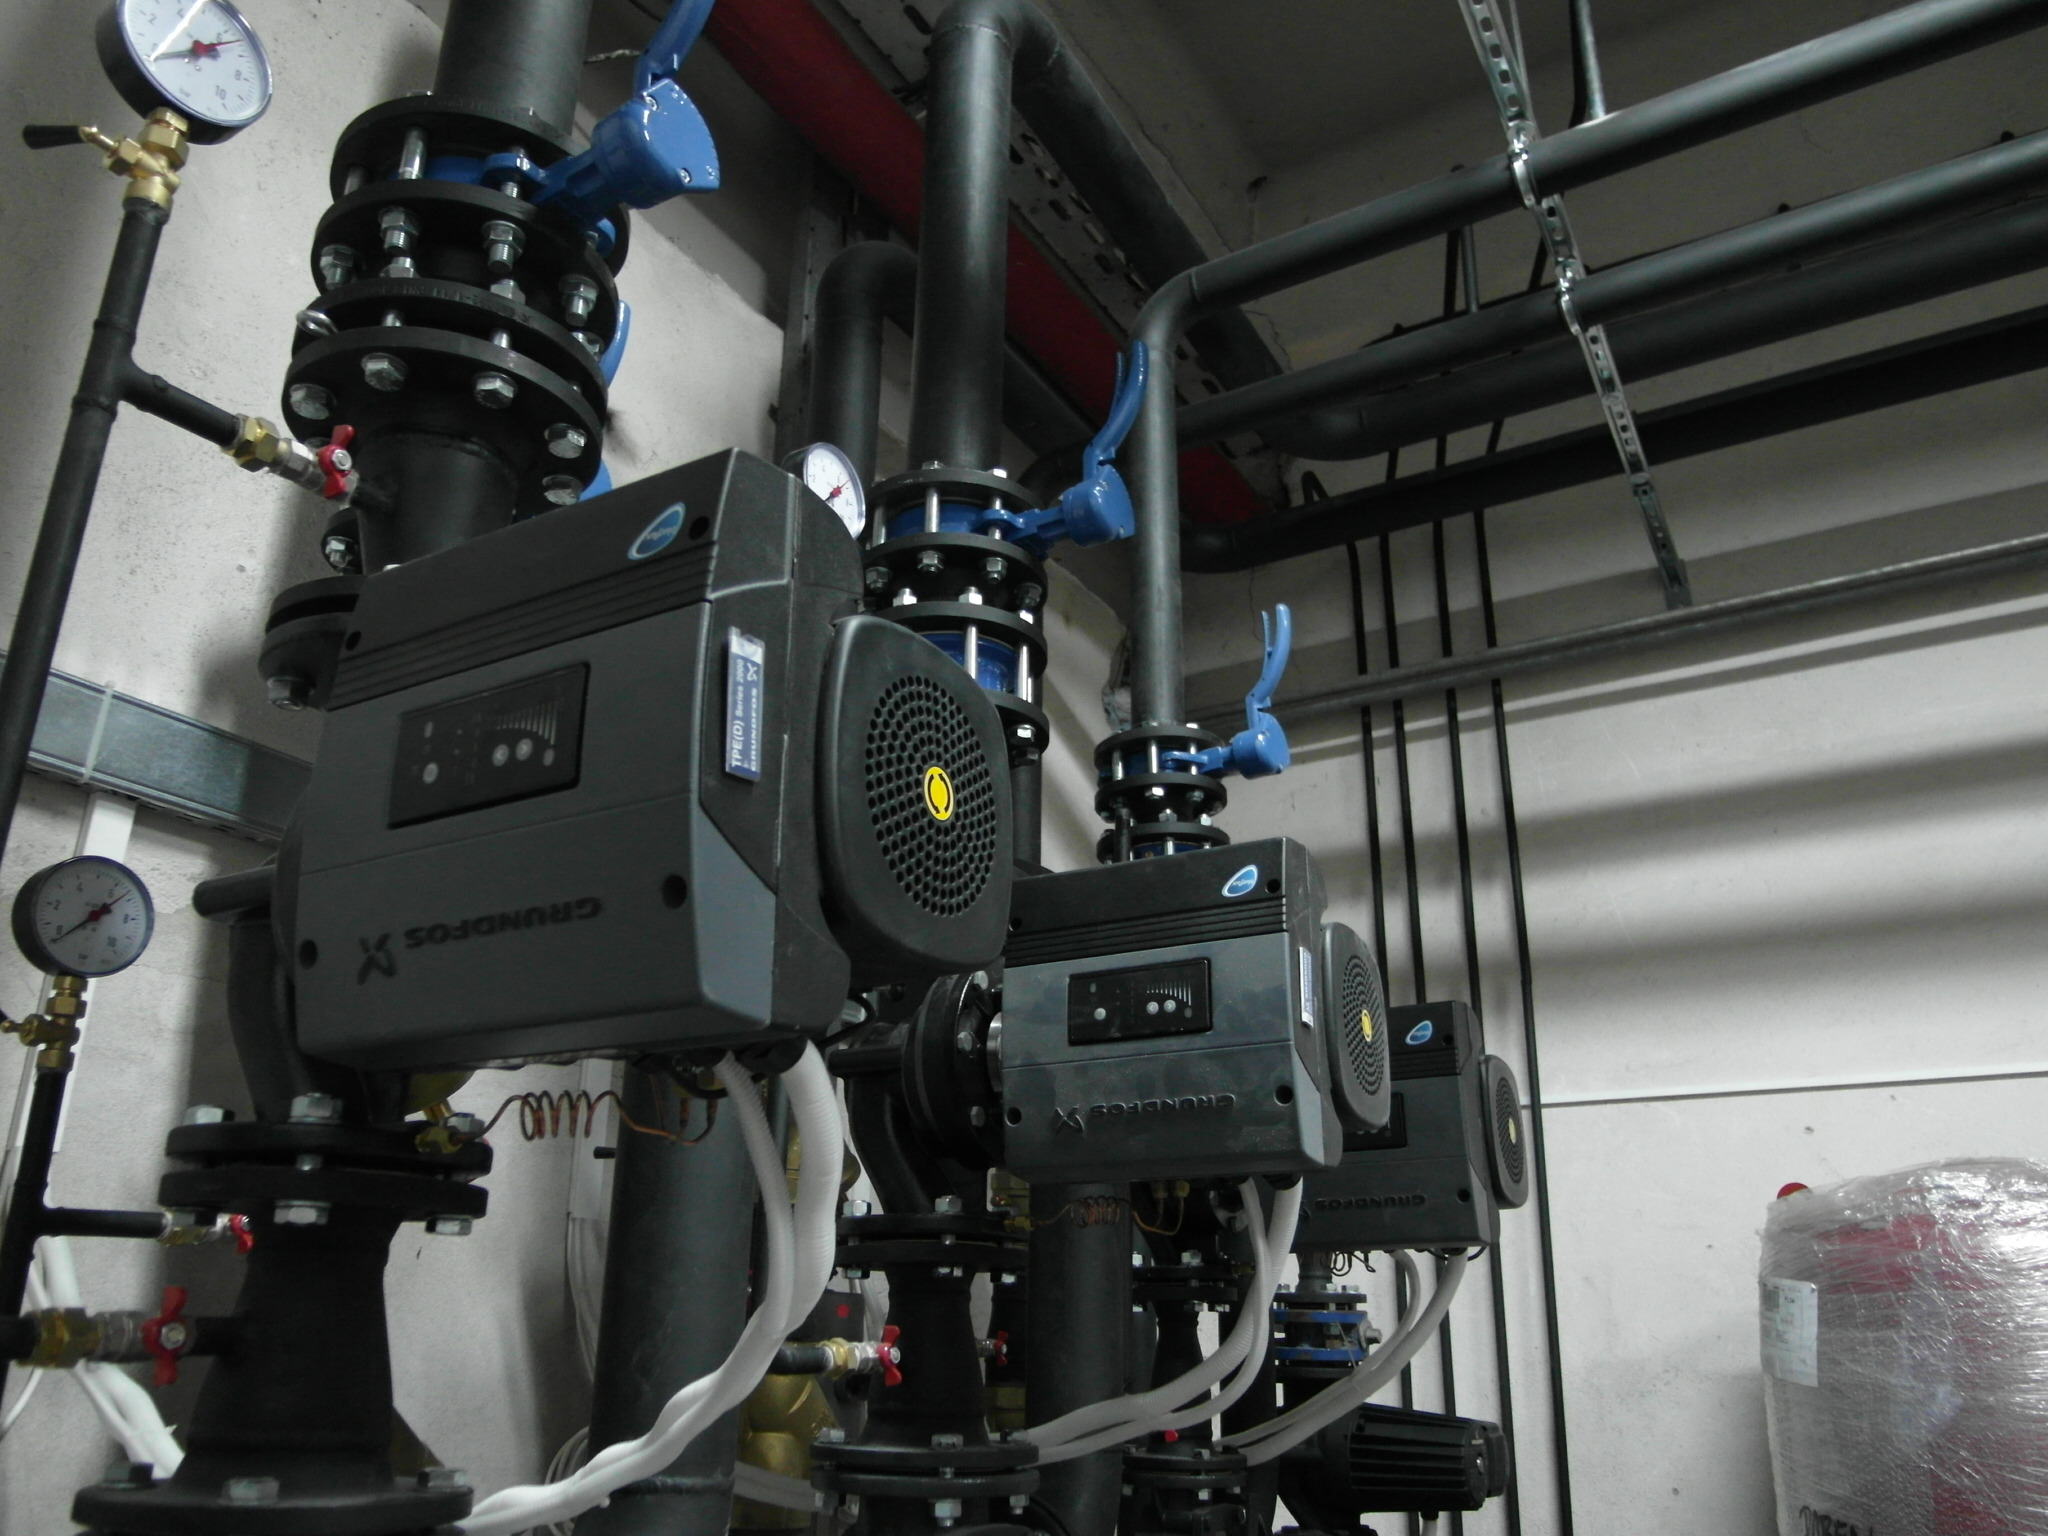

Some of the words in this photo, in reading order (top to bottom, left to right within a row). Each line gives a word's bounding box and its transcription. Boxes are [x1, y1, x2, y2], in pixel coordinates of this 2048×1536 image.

[215, 85, 227, 100] 10
[735, 685, 744, 717] Series
[731, 720, 744, 767] TPE(D)
[404, 897, 603, 949] GRUNDFOS
[1090, 1093, 1235, 1115] GRUNDFOS
[1314, 1194, 1427, 1211] GRUNDFOS
